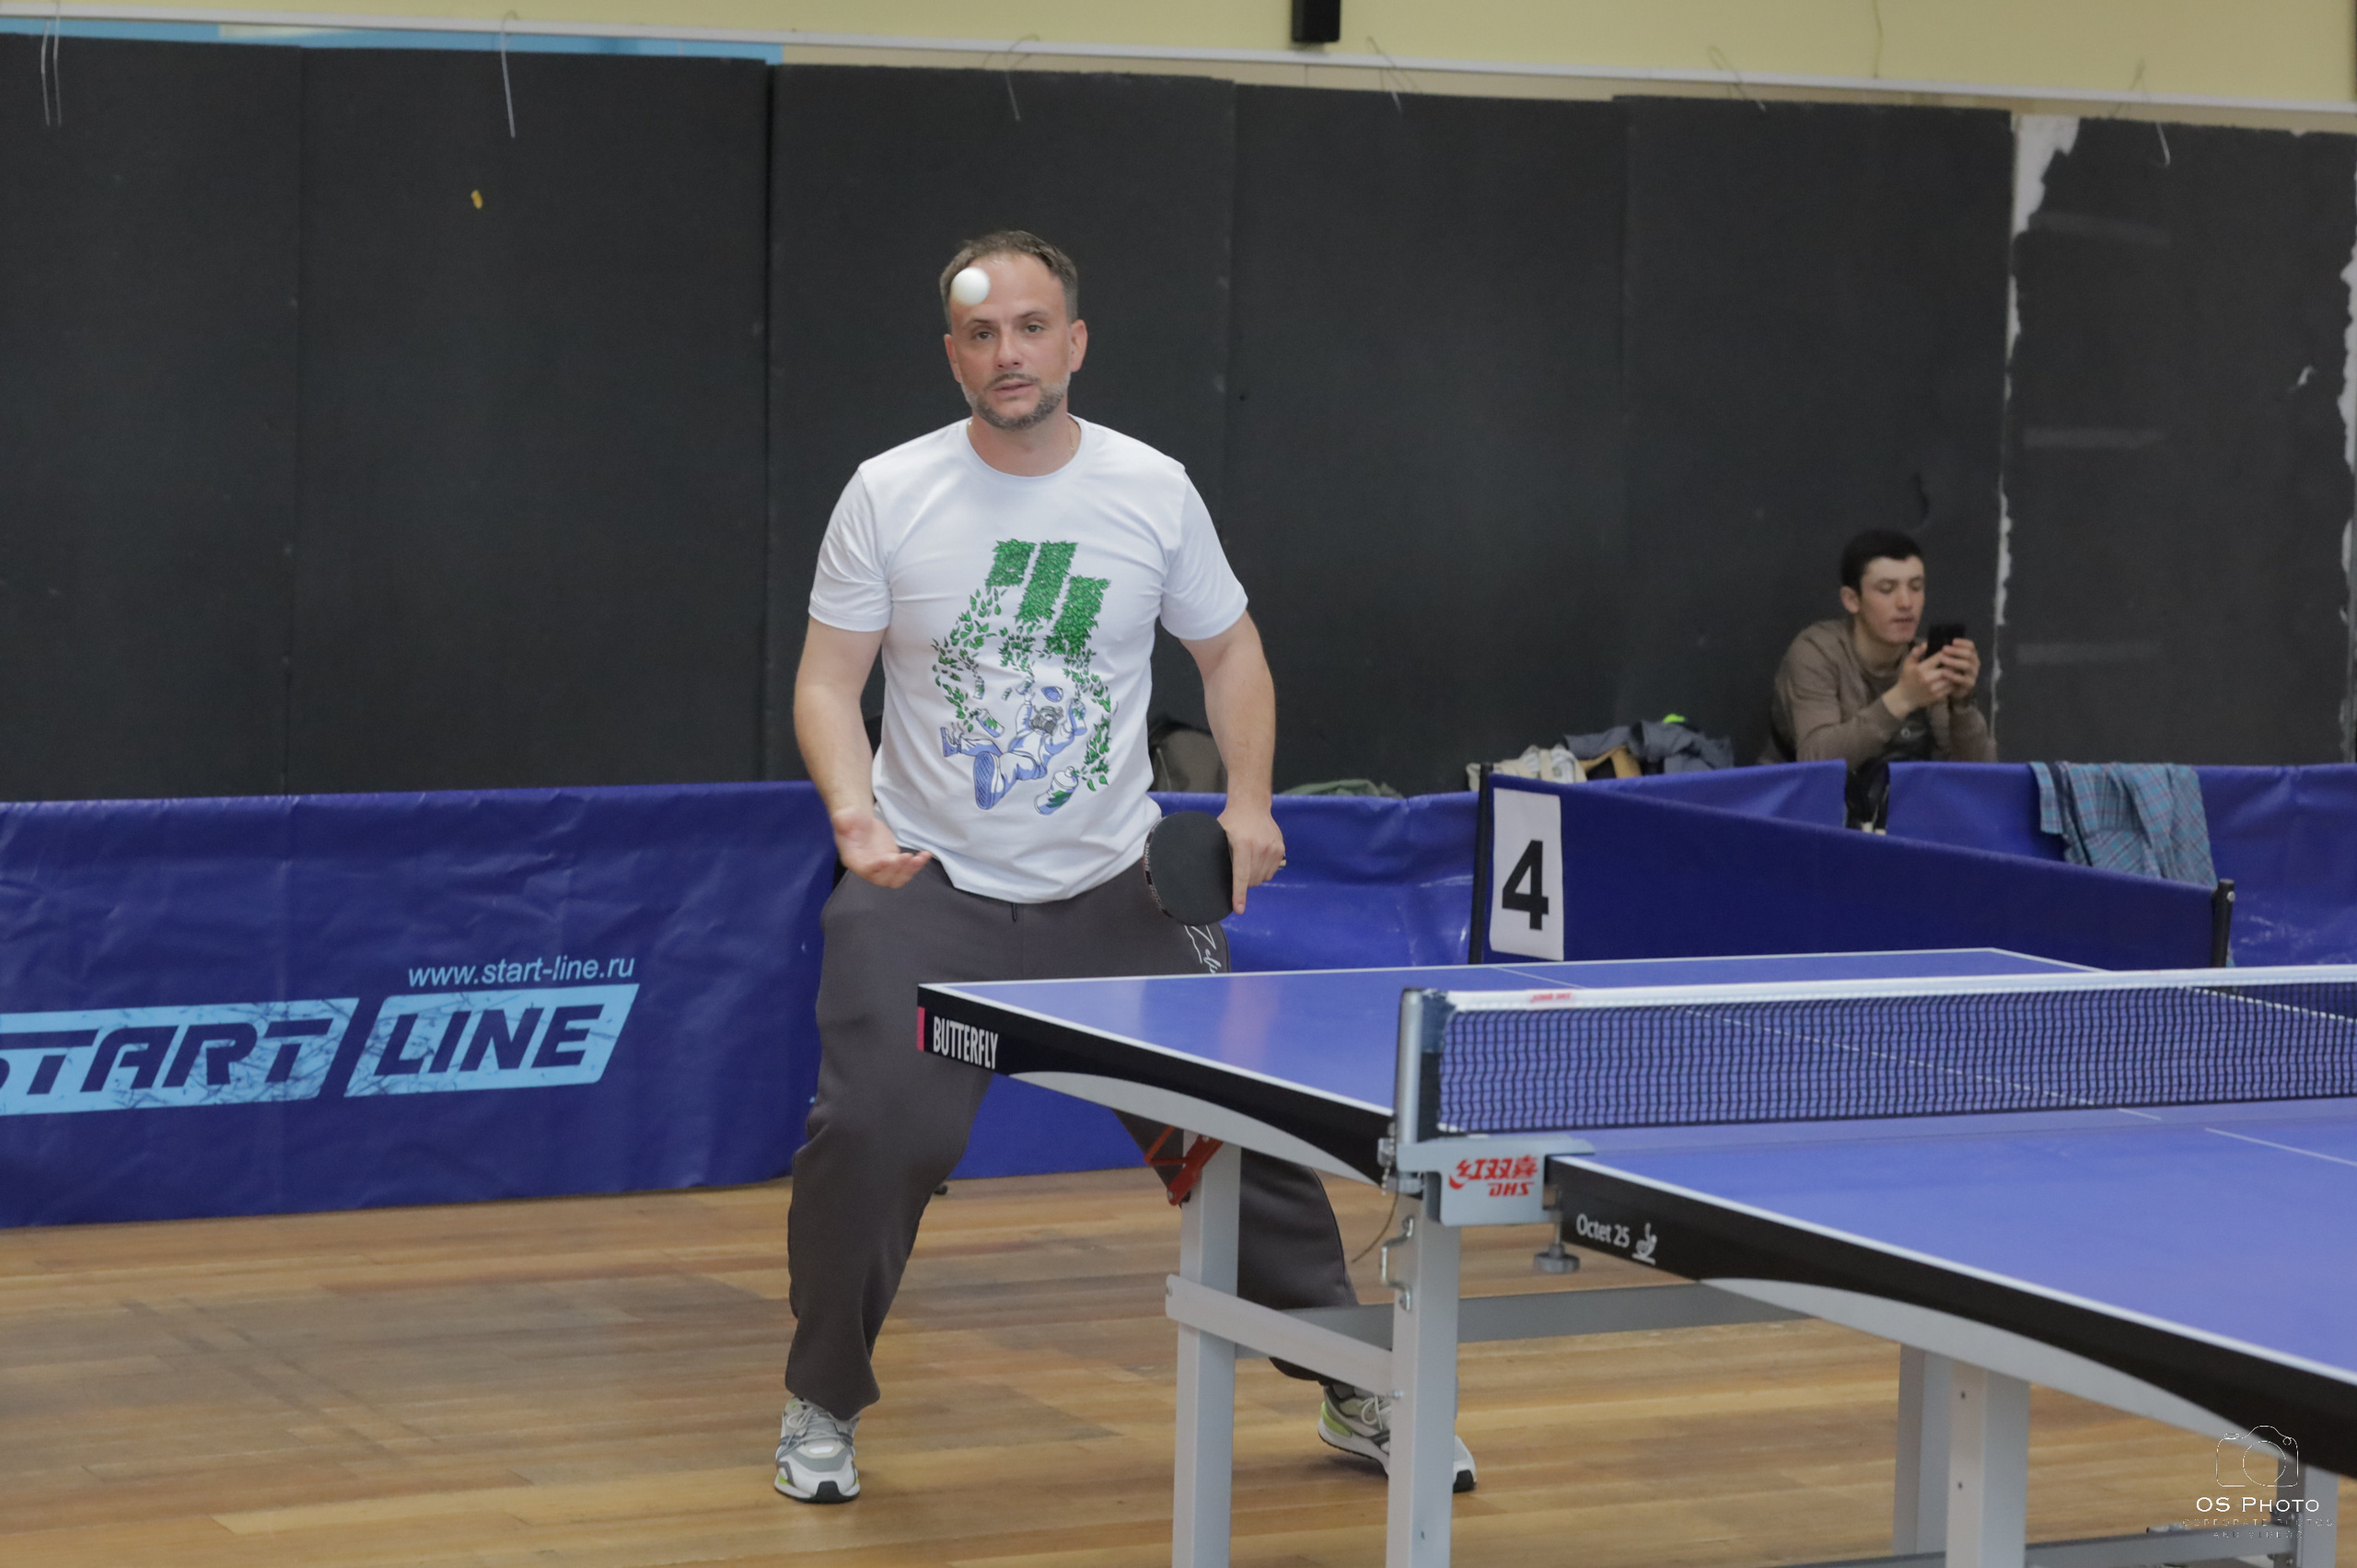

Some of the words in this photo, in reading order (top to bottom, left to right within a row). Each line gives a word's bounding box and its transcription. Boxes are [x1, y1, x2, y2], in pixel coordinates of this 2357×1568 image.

[1502, 839, 1549, 931] 4
[408, 956, 635, 988] www.start-line.ru
[373, 1004, 604, 1077] LINE
[933, 1016, 998, 1070] BUTTERFLY
[1488, 1181, 1535, 1197] DHS
[1576, 1213, 1611, 1244] Octet
[1613, 1224, 1630, 1248] 25
